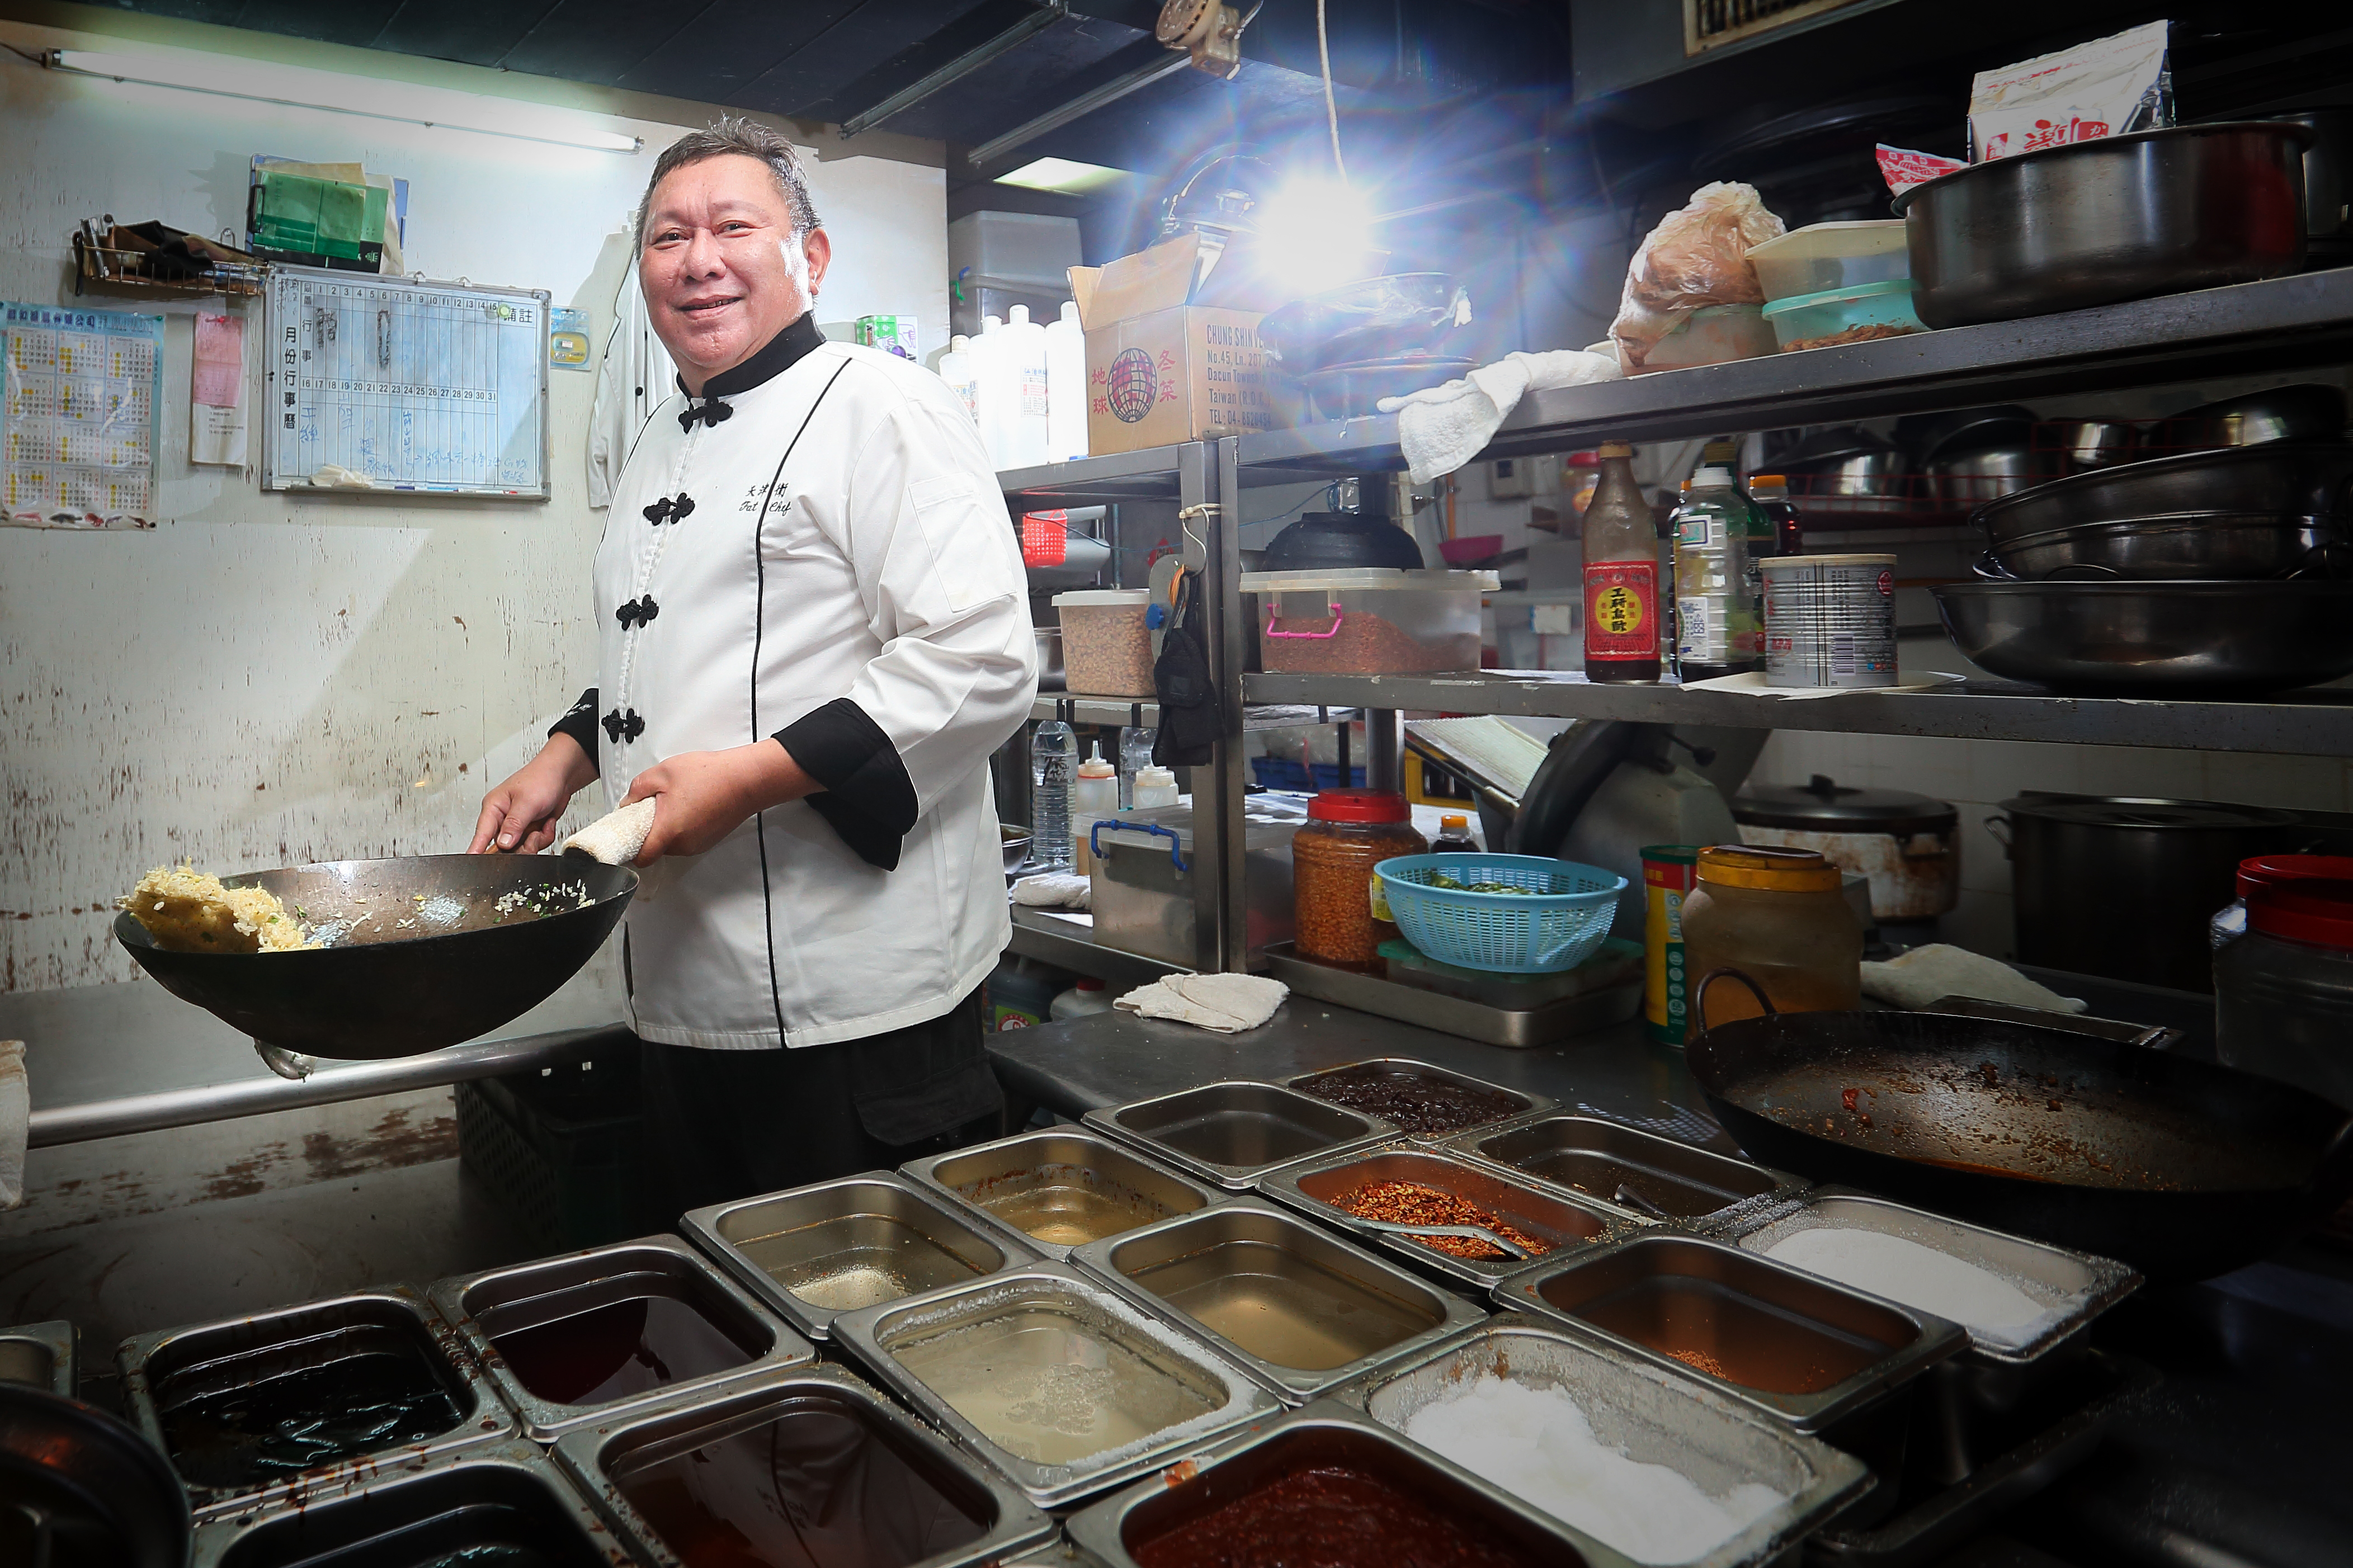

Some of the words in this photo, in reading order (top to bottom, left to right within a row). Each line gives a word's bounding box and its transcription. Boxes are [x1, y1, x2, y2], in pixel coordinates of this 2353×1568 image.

[319, 285, 322, 294] 1
[331, 286, 336, 295] 2
[344, 287, 349, 296] 3
[430, 296, 437, 305] 10
[442, 297, 449, 306] 11
[454, 299, 461, 307] 12
[466, 300, 473, 308] 13
[1207, 324, 1233, 346] CHUNG
[1235, 327, 1253, 347] SHIN
[1236, 352, 1246, 366] Ln.
[284, 326, 296, 429] 月份行事曆
[1157, 350, 1178, 403] 冬菜
[1207, 367, 1231, 381] Dacun
[302, 379, 310, 388] 16
[315, 380, 323, 389] 17
[328, 381, 336, 389] 18
[353, 382, 363, 391] 20
[366, 383, 375, 392] 21
[379, 384, 388, 393] 22
[404, 386, 413, 394] 24
[416, 387, 425, 395] 25
[428, 388, 437, 396] 26
[440, 389, 449, 397] 27
[452, 390, 461, 398] 28
[475, 391, 484, 400] 30
[488, 392, 496, 400] 31
[1092, 366, 1109, 415] 地球
[1209, 388, 1237, 404] Taiwan
[739, 500, 758, 511] Fat
[769, 500, 791, 516] Chef
